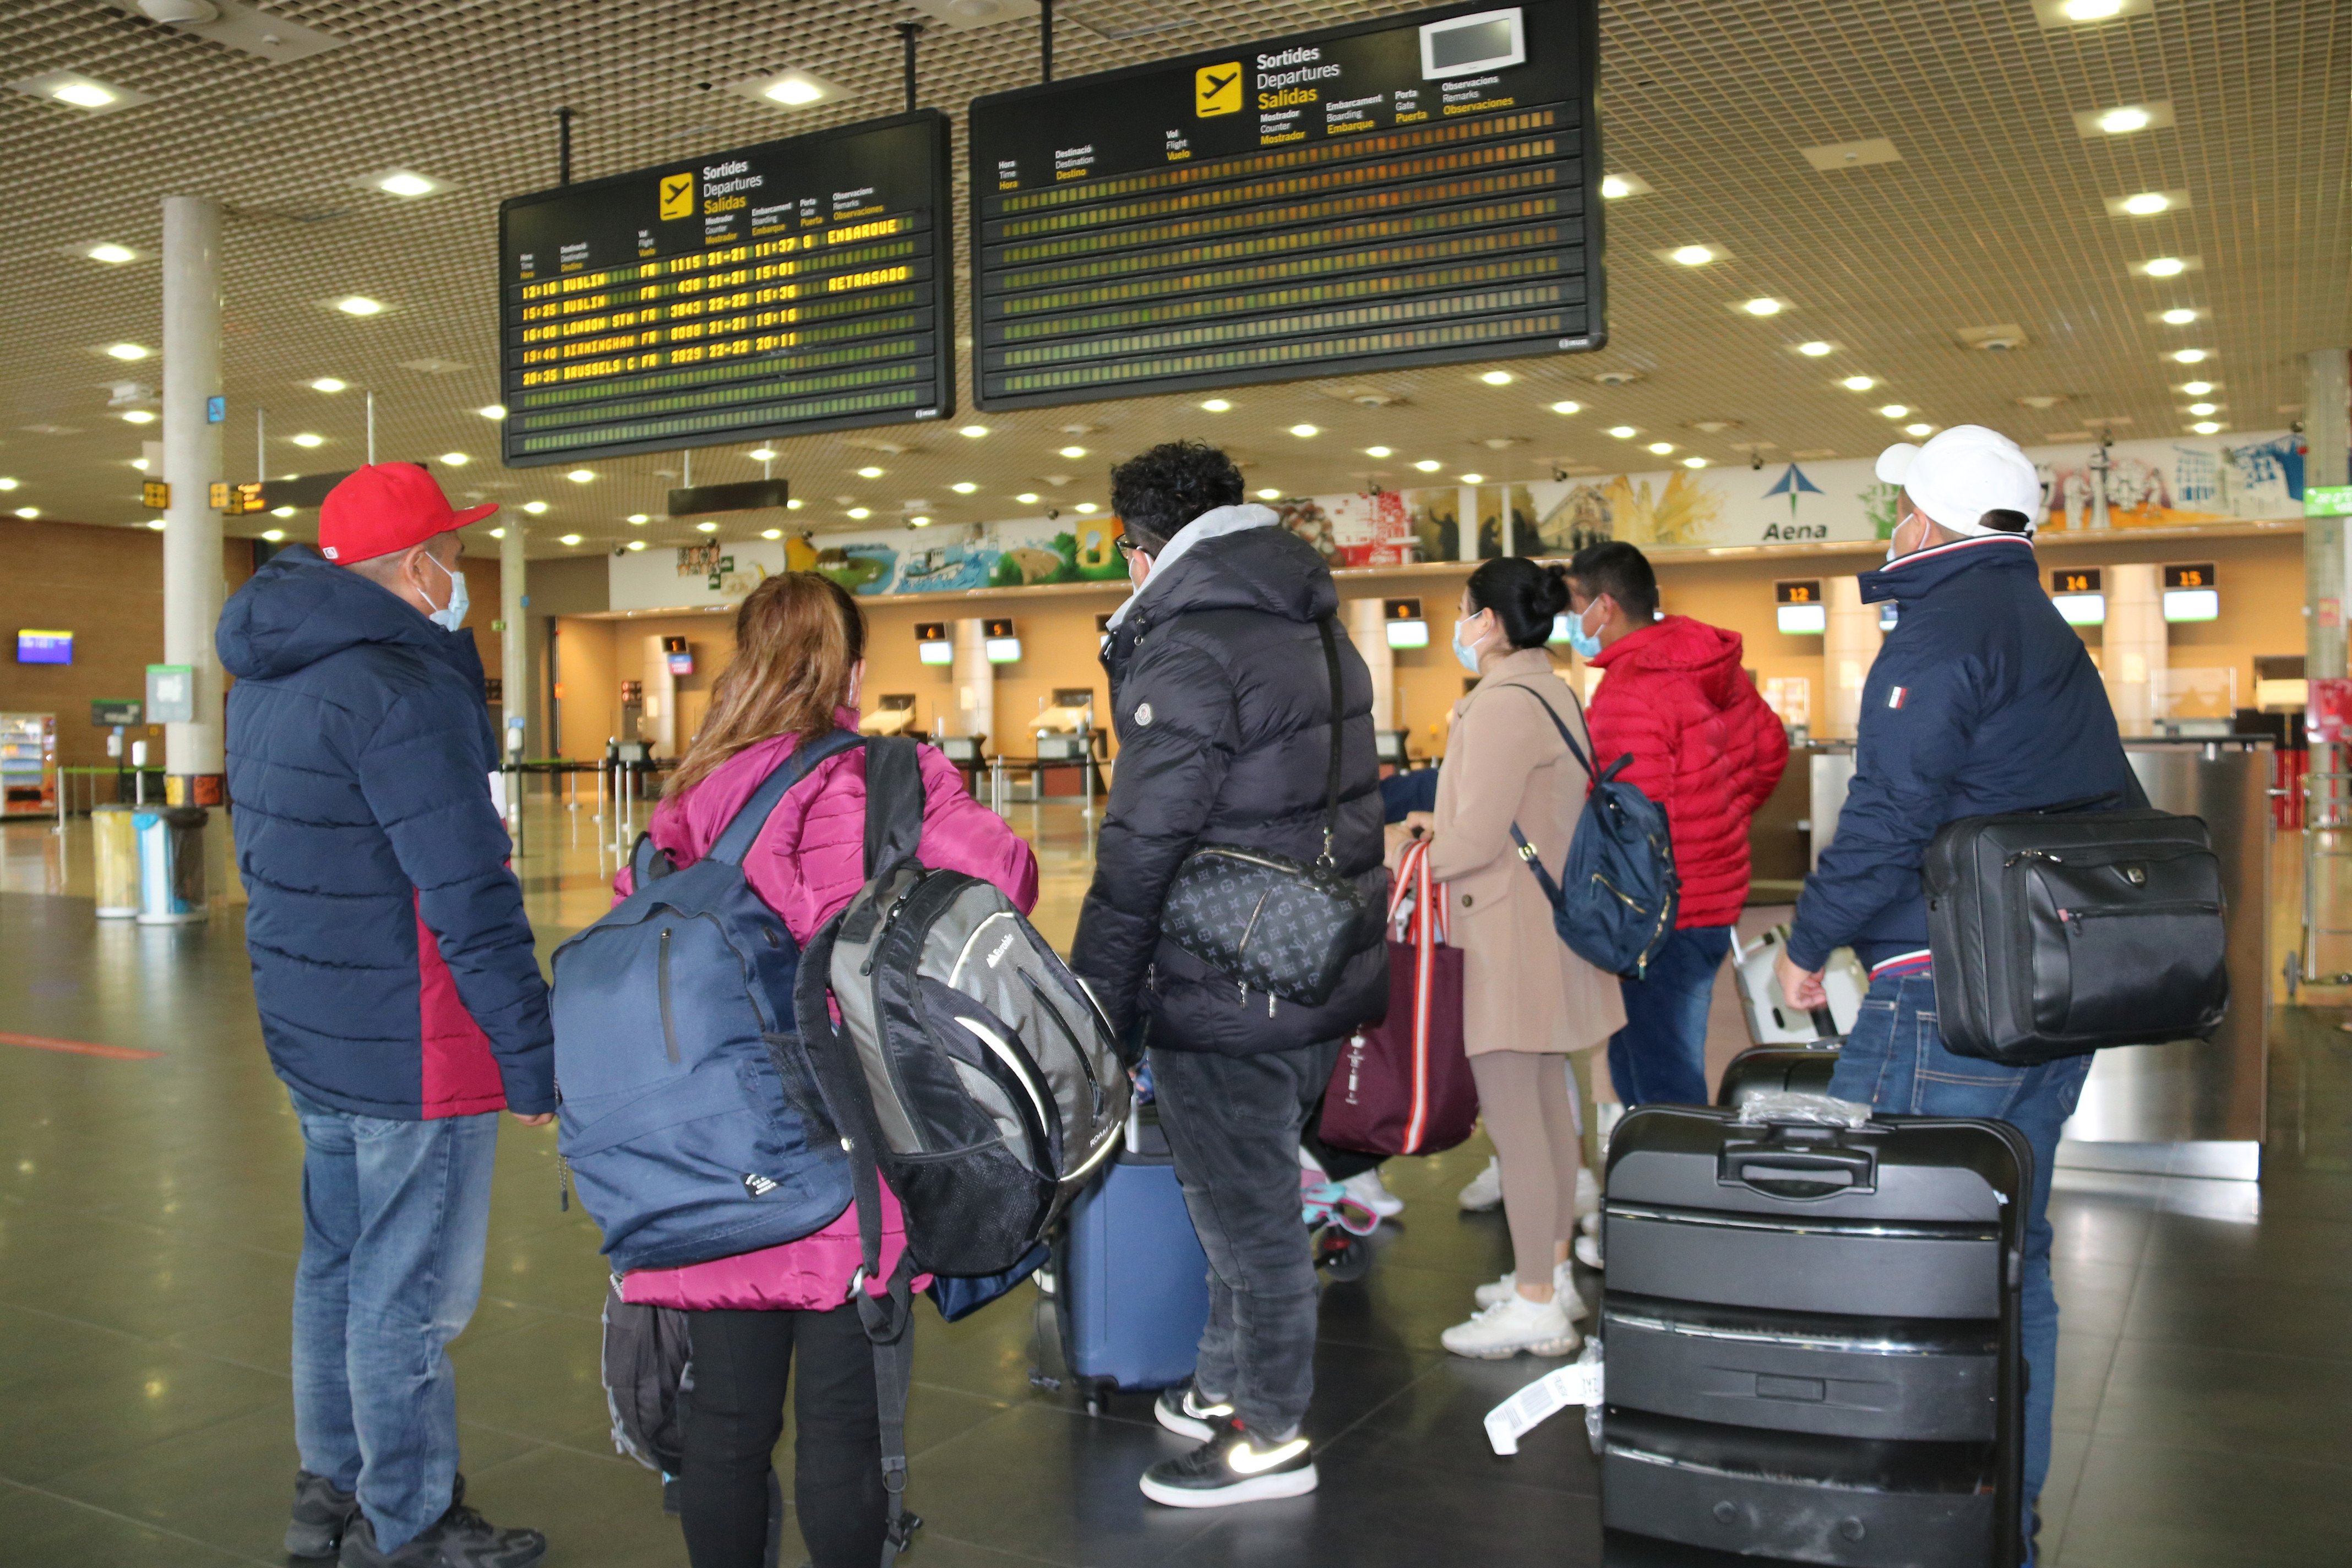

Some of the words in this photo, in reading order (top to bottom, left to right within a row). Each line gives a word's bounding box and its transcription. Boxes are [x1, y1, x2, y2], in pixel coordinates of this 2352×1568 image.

[1256, 47, 1321, 70] Sortides
[1256, 64, 1341, 90] Departures
[1442, 75, 1500, 91] Observacions
[1257, 88, 1319, 110] Salidas
[1395, 89, 1419, 100] Porta
[1442, 90, 1480, 103] Remarks
[1326, 94, 1383, 111] Embarcament
[1395, 100, 1416, 111] Gate
[1443, 96, 1515, 115] Observaciones
[1260, 110, 1300, 122] Mostrador
[1326, 109, 1363, 122] Boarding
[1395, 110, 1428, 123] Puerta
[1260, 122, 1292, 134] Counter
[1327, 118, 1375, 134] Embarque
[1166, 129, 1179, 139] Vol
[1260, 130, 1306, 145] Mostrador
[1055, 144, 1093, 159] Destinació
[1166, 139, 1188, 150] Flight
[1055, 155, 1095, 170] Destination
[1167, 150, 1191, 161] Vuelo
[703, 161, 749, 181] Sortides
[998, 160, 1016, 170] Hora
[999, 170, 1017, 179] Time
[1056, 168, 1087, 181] Destino
[704, 175, 764, 198] Departures
[999, 180, 1018, 190] Hora
[832, 186, 876, 202] Observacions
[704, 195, 748, 215] Salidas
[752, 202, 794, 217] Embarcament
[800, 198, 818, 207] Porta
[833, 198, 861, 210] Remarks
[705, 214, 735, 226] Mostrador
[752, 214, 779, 226] Boarding
[800, 208, 816, 217] Gate
[834, 205, 885, 221] Observaciones
[801, 216, 825, 227] Puerta
[705, 224, 729, 235] Counter
[752, 223, 787, 236] Embarque
[705, 232, 739, 245] Mostrador
[522, 281, 557, 299] 12:10
[563, 273, 606, 292] DUBLIN
[640, 263, 657, 278] FR
[670, 254, 702, 273] 1115
[707, 247, 747, 266] 21-21
[755, 237, 797, 258] 11:37
[803, 235, 812, 248] 8
[827, 218, 899, 244] EMBARQUE
[523, 303, 557, 321] 15:25
[563, 295, 606, 314] DUBLIN
[640, 285, 657, 300] FR
[677, 277, 701, 293] 438
[708, 269, 747, 288] 21-21
[755, 260, 796, 280] 15:01
[523, 324, 558, 342] 16:00
[563, 316, 606, 336] LONDON
[612, 312, 635, 328] STN
[641, 308, 657, 323] FR
[670, 300, 702, 318] 3843
[708, 292, 748, 312] 22-22
[756, 284, 797, 303] 15:36
[828, 265, 907, 291] RETRASADO
[524, 346, 558, 364] 19:40
[563, 335, 635, 358] BIRMINGHAM
[641, 330, 657, 345] FR
[671, 323, 702, 341] 8088
[709, 315, 748, 335] 21-21
[756, 308, 797, 327] 19:16
[523, 367, 558, 385] 20:35
[563, 358, 621, 380] BRUSSELS
[627, 356, 635, 369] C
[641, 353, 657, 368] FR
[671, 346, 702, 364] 2829
[709, 339, 748, 358] 22-22
[756, 331, 797, 351] 20:11
[1763, 522, 1827, 540] Aena
[2066, 575, 2088, 591] 14
[2179, 570, 2202, 586] 15
[1789, 587, 1810, 602] 12
[993, 934, 1014, 957] Eurohike
[1090, 1125, 1108, 1148] ROAM
